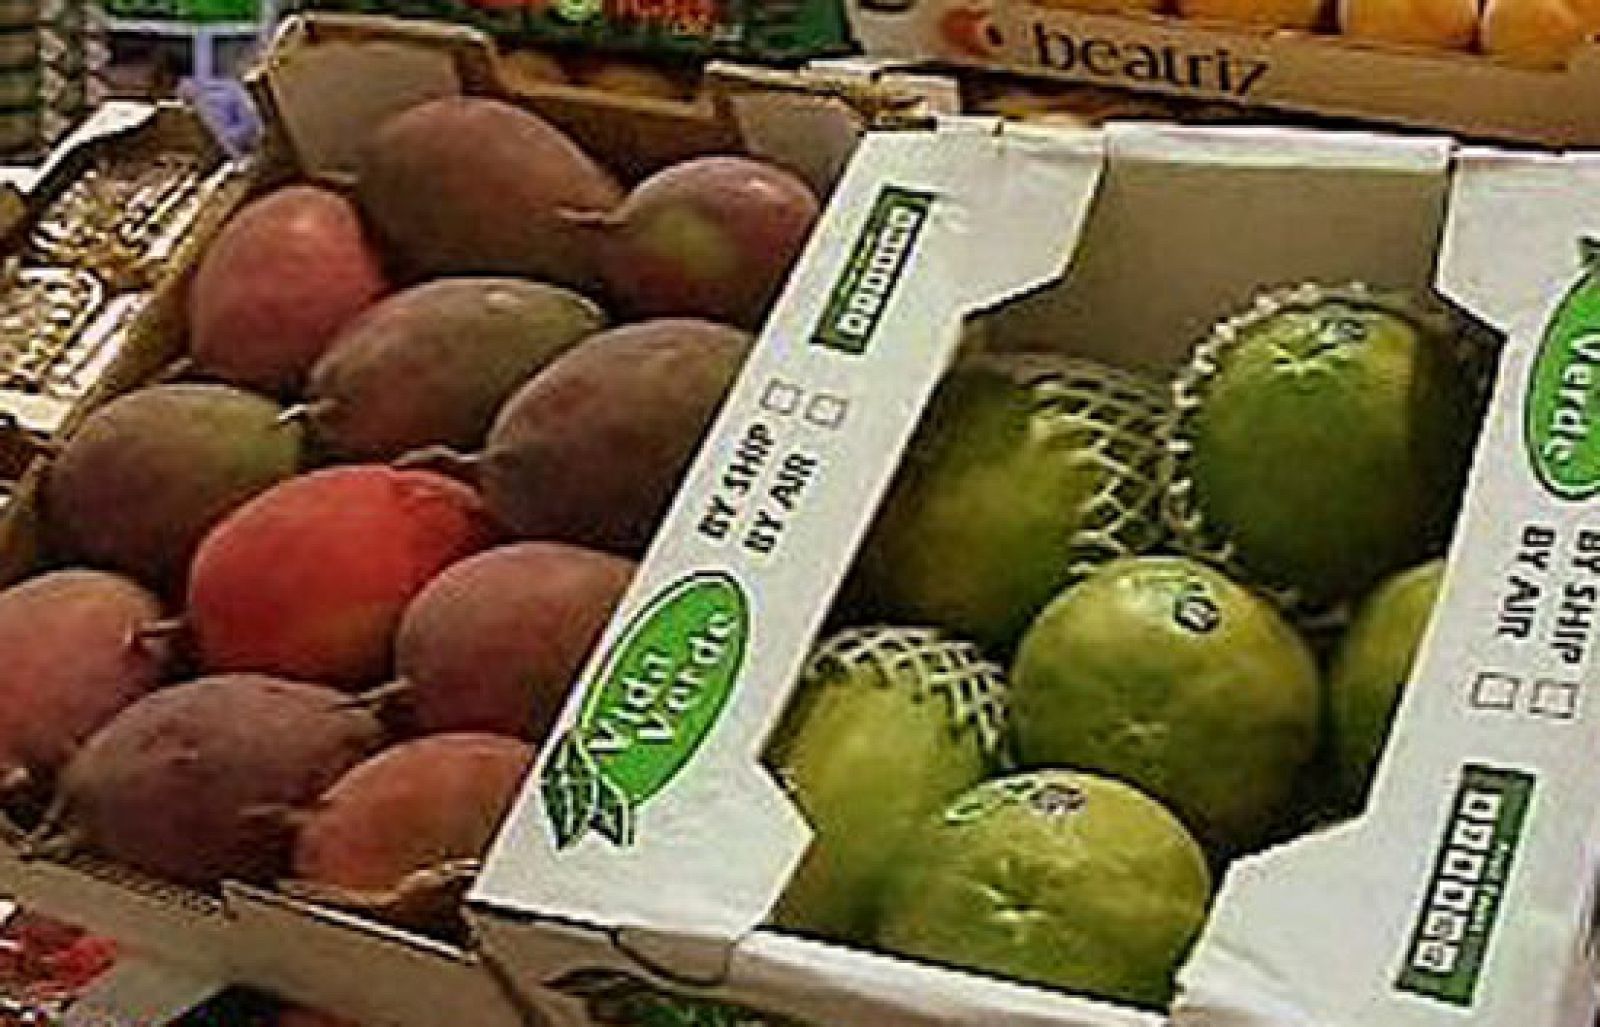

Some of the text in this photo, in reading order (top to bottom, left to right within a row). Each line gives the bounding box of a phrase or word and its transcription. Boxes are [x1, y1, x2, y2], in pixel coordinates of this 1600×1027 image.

[1033, 22, 1271, 96] beatriz
[698, 424, 774, 538] BY SHIP
[742, 453, 817, 553] BY AIR
[1498, 526, 1555, 638] BY AIR
[1551, 582, 1596, 663] SHIP
[636, 612, 738, 741] Verde
